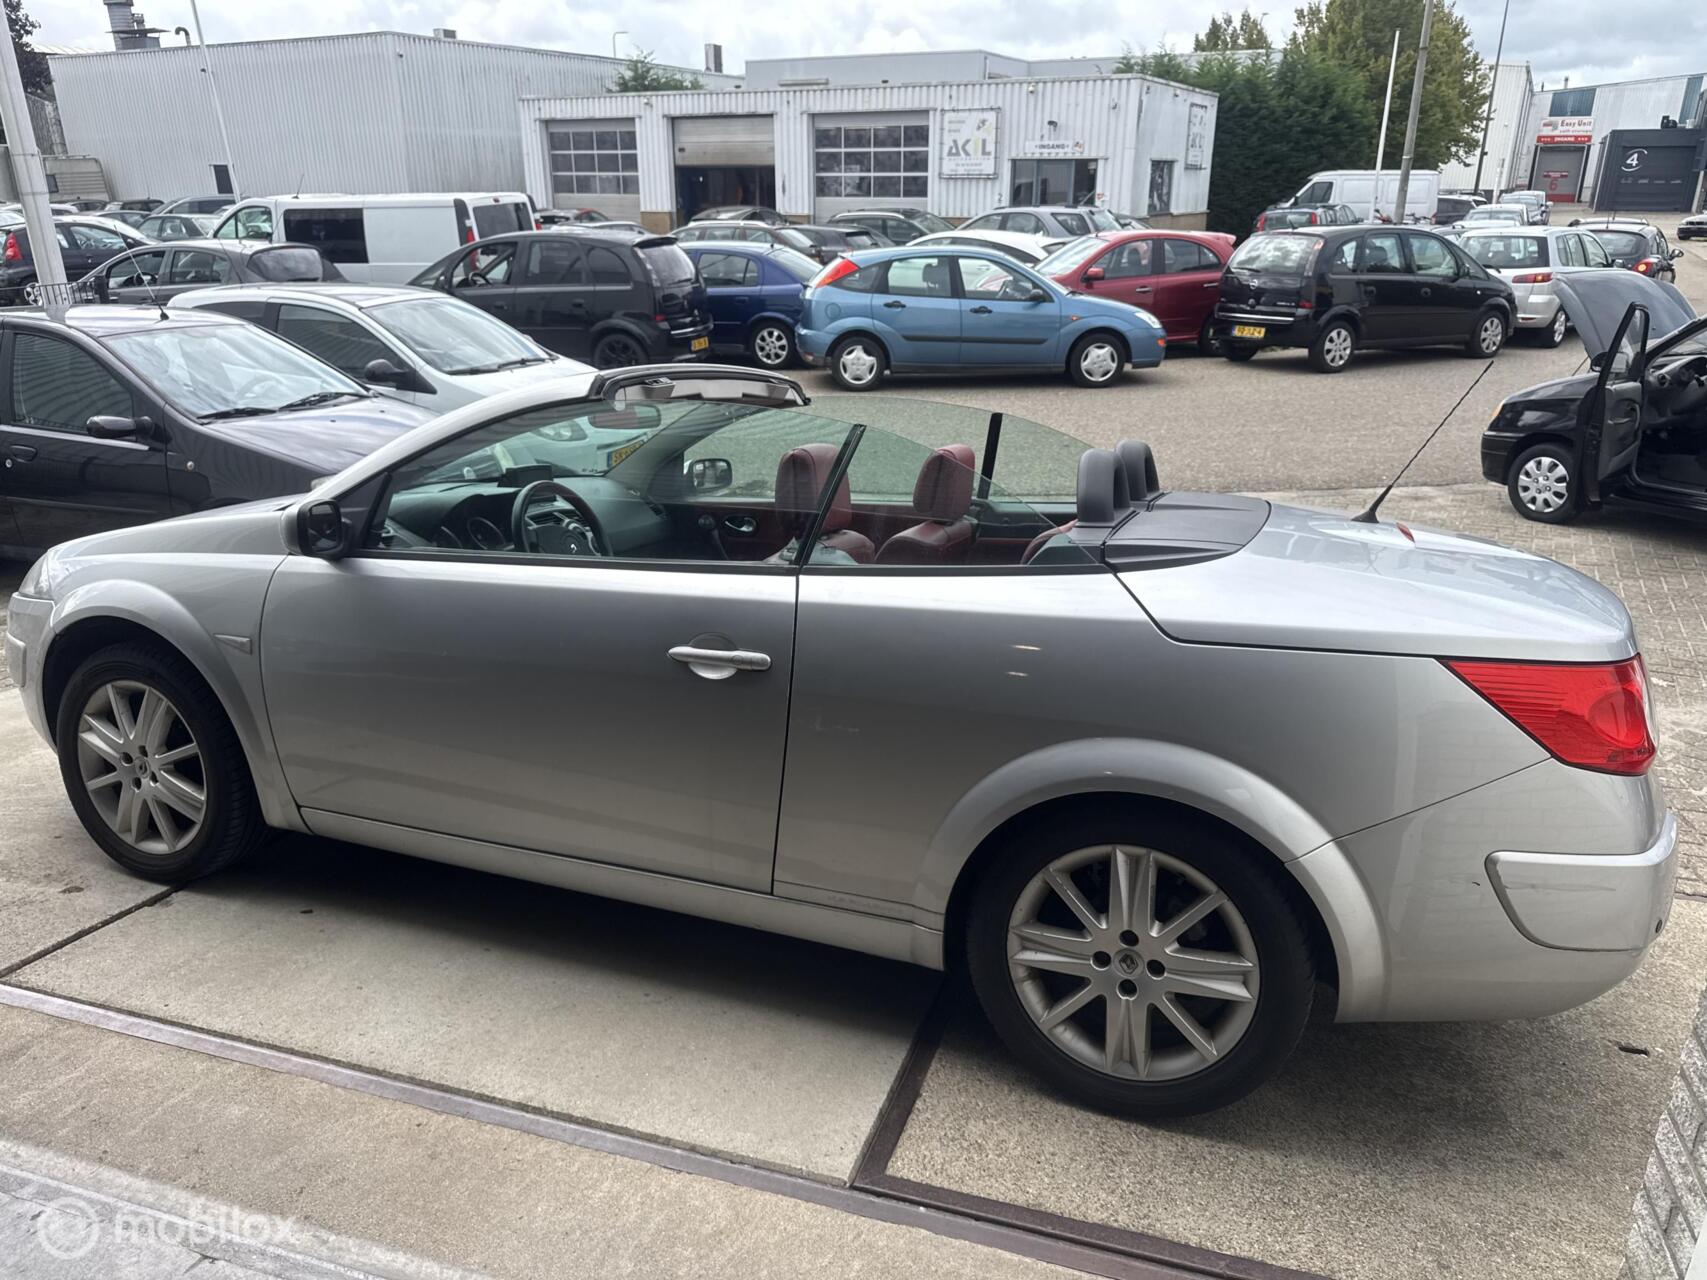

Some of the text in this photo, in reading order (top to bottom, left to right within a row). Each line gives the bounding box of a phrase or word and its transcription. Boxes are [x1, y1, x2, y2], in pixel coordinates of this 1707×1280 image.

[1560, 119, 1592, 128] Easy Unit
[947, 138, 992, 157] AKIL
[1626, 153, 1638, 166] 4
